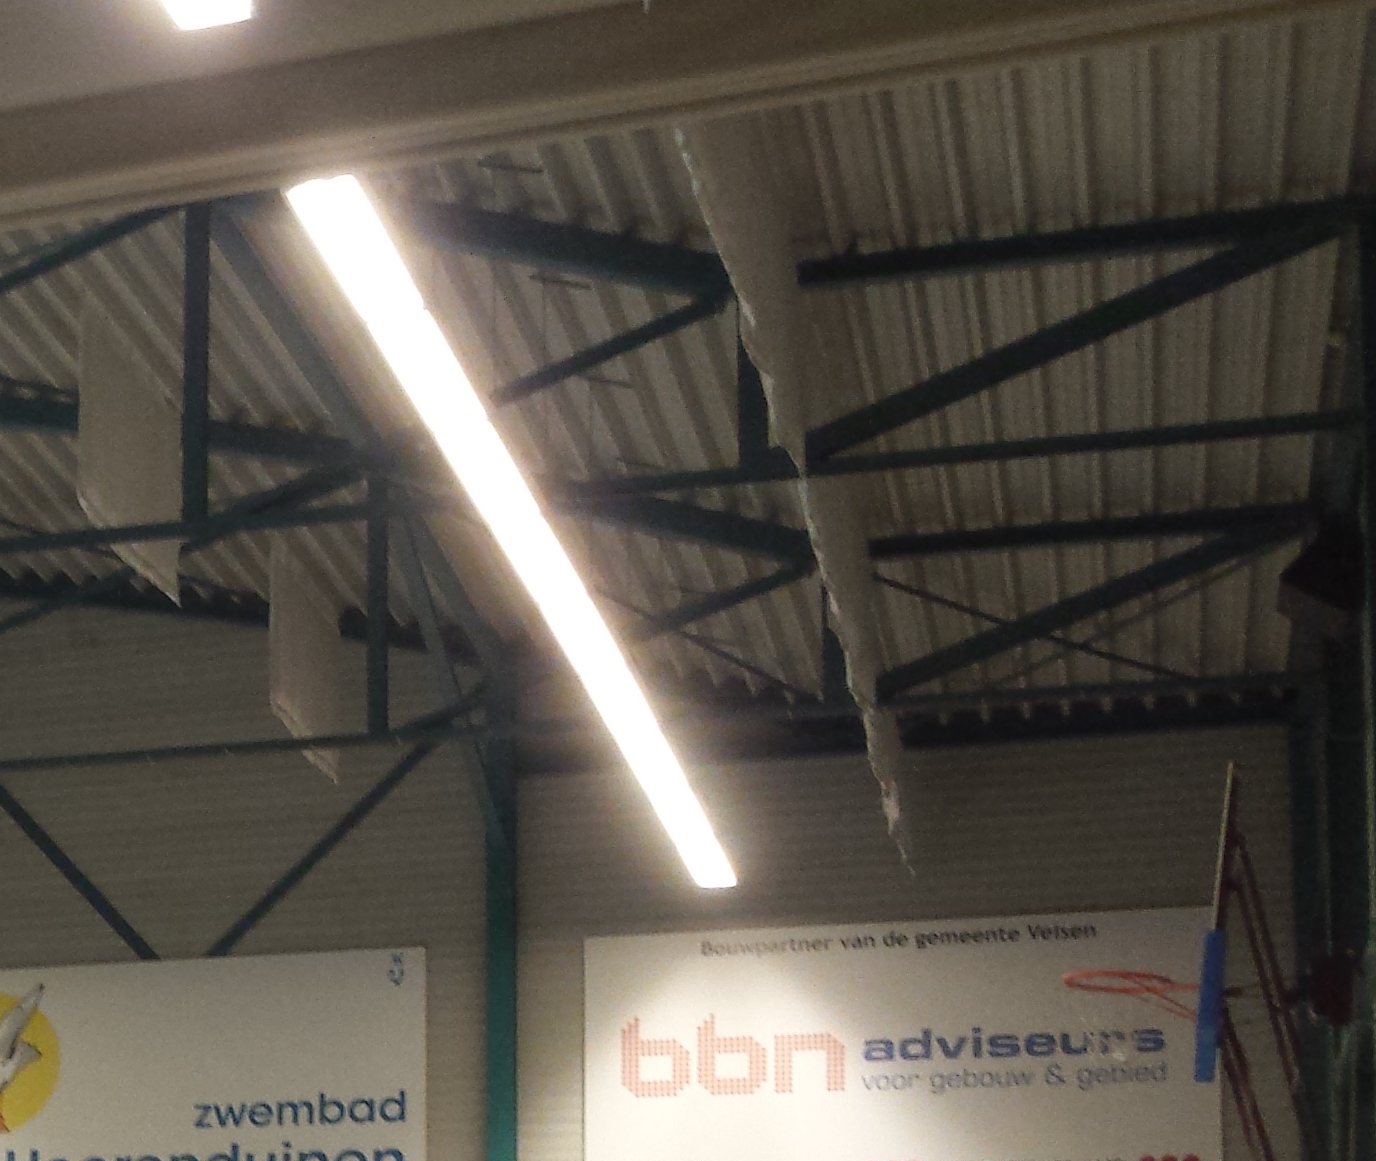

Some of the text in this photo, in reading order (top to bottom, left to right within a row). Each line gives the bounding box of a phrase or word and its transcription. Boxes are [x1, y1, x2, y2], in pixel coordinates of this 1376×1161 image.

[840, 934, 877, 949] van
[882, 930, 909, 947] de
[915, 928, 1020, 949] gemeente
[621, 1013, 1166, 1098] bbn adviseurs
[862, 1074, 919, 1091] voor
[930, 1067, 1034, 1093] gebouw
[194, 1090, 406, 1130] zwembad
